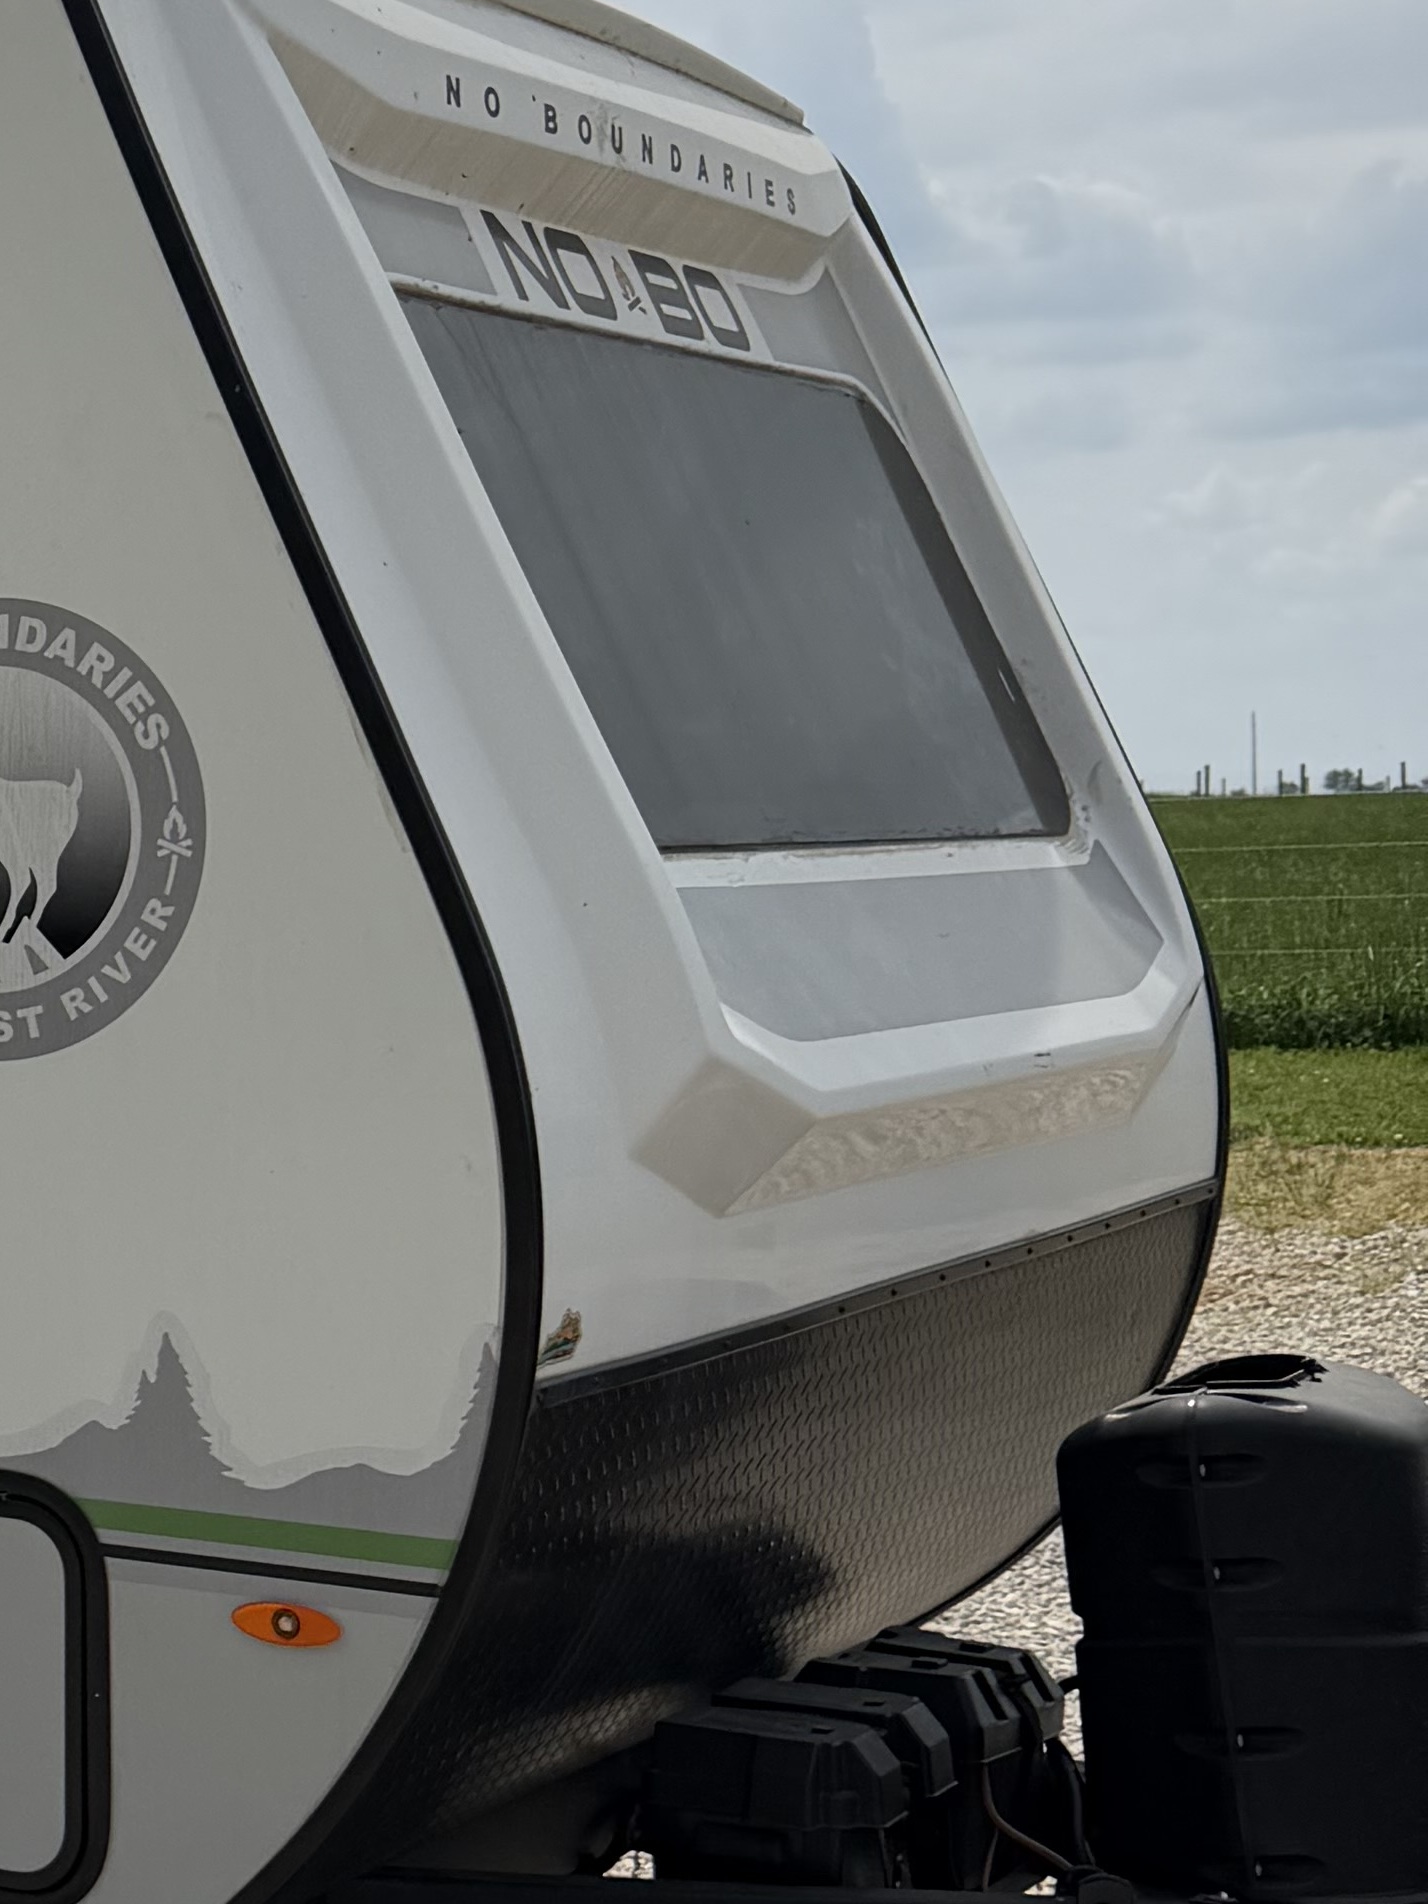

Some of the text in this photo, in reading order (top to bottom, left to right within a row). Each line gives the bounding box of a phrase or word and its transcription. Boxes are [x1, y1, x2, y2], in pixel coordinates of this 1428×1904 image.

[445, 74, 797, 216] NO BOUNDARIES
[59, 898, 175, 1021] RIVER
